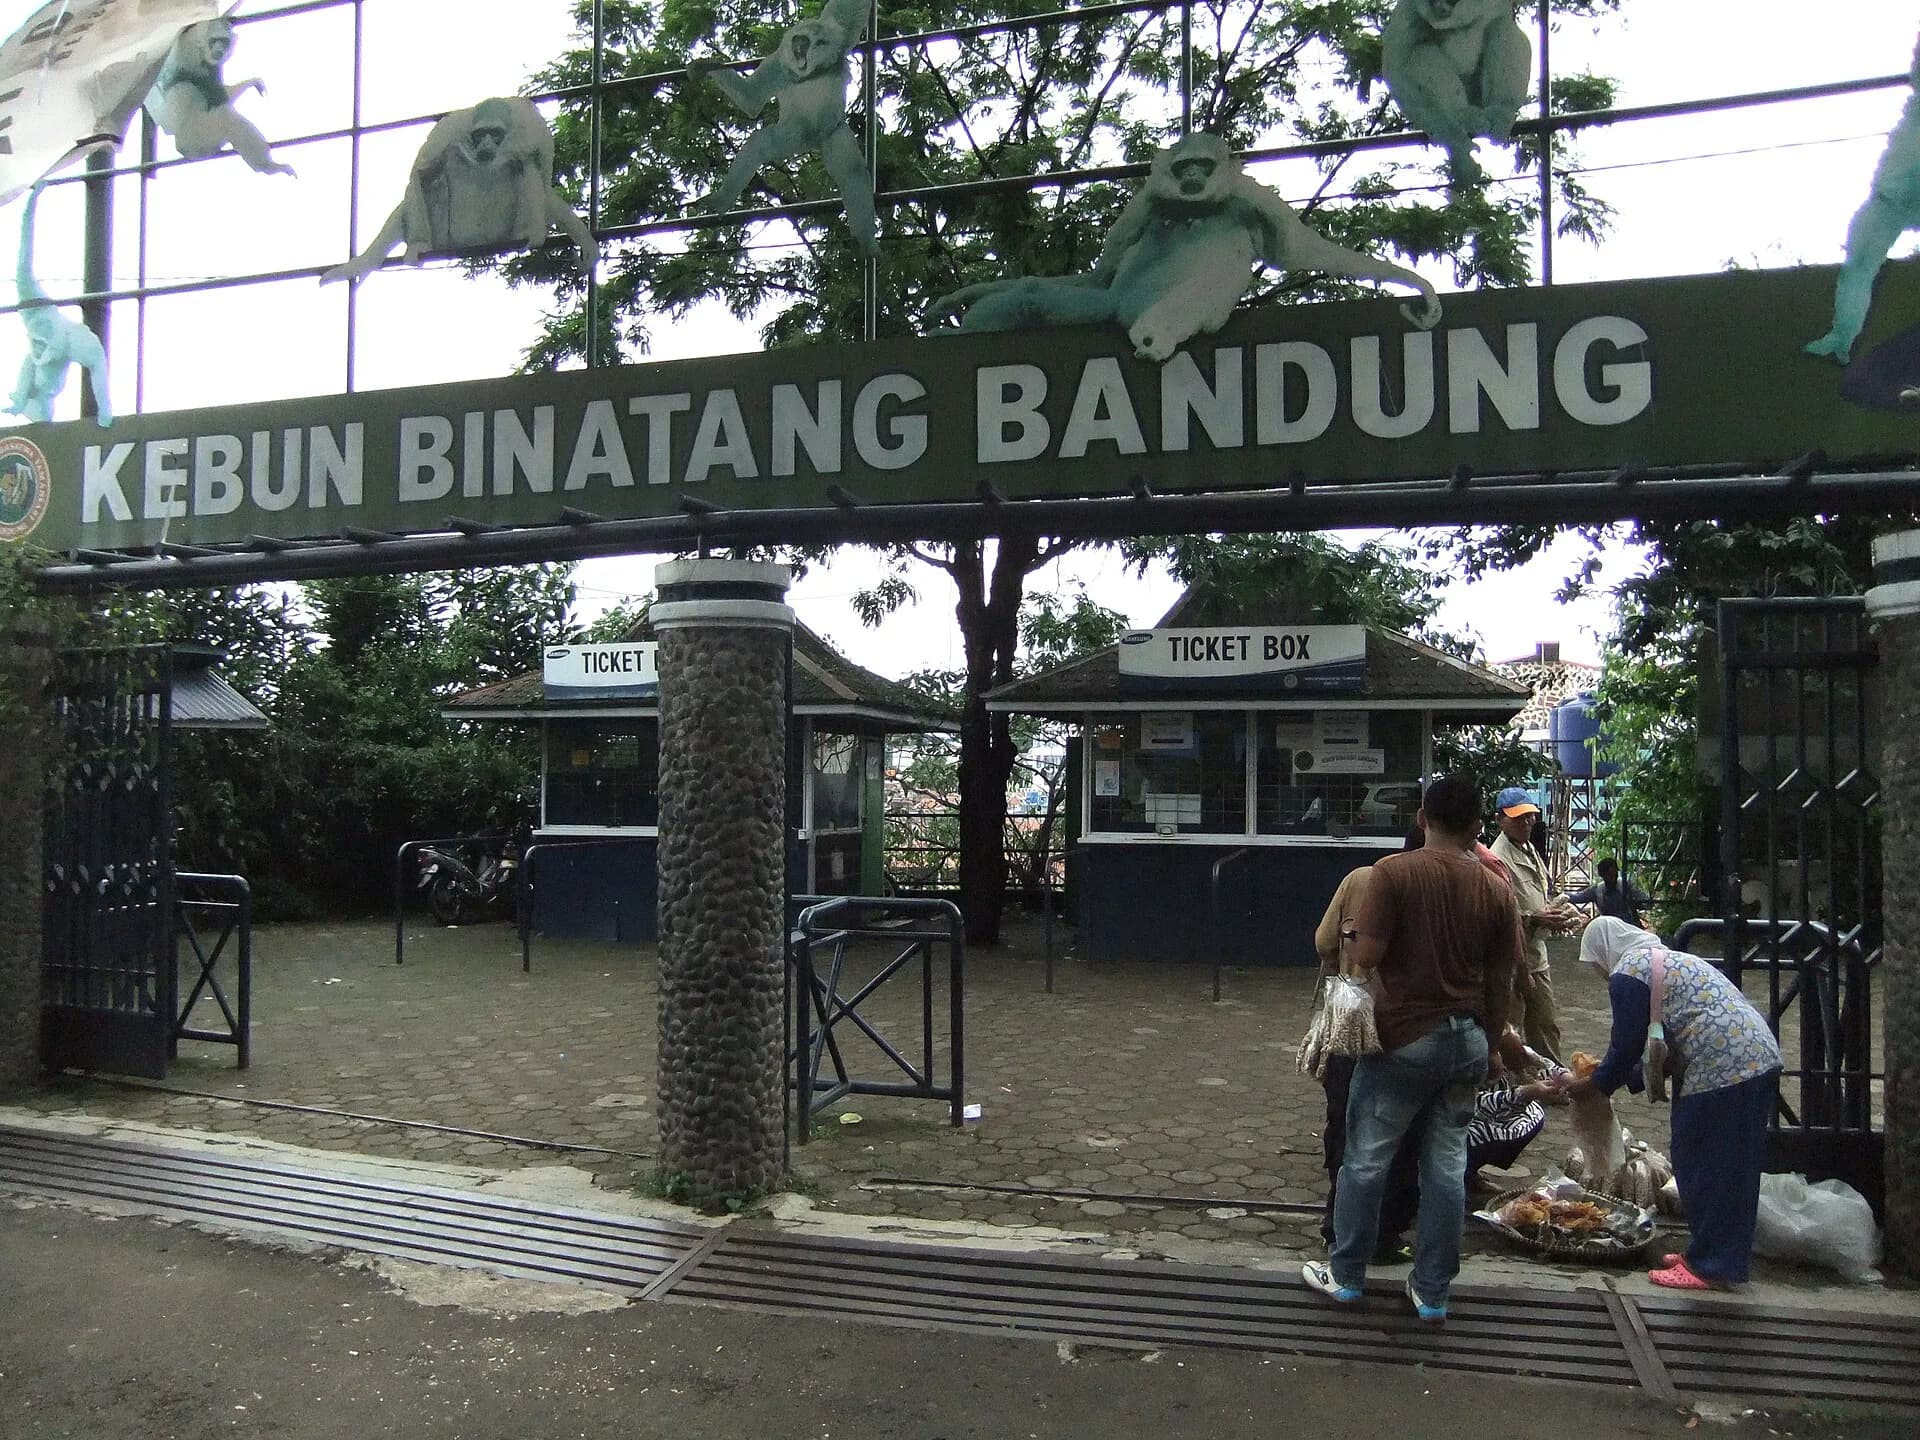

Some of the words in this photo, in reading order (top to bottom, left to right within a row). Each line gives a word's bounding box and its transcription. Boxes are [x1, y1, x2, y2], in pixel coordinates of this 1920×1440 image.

[82, 422, 364, 523] KEBUN
[399, 373, 928, 502] BINATANG
[976, 315, 1652, 464] BANDUNG
[581, 650, 644, 673] TICKET
[1168, 635, 1250, 662] TICKET
[1263, 634, 1310, 661] BOX
